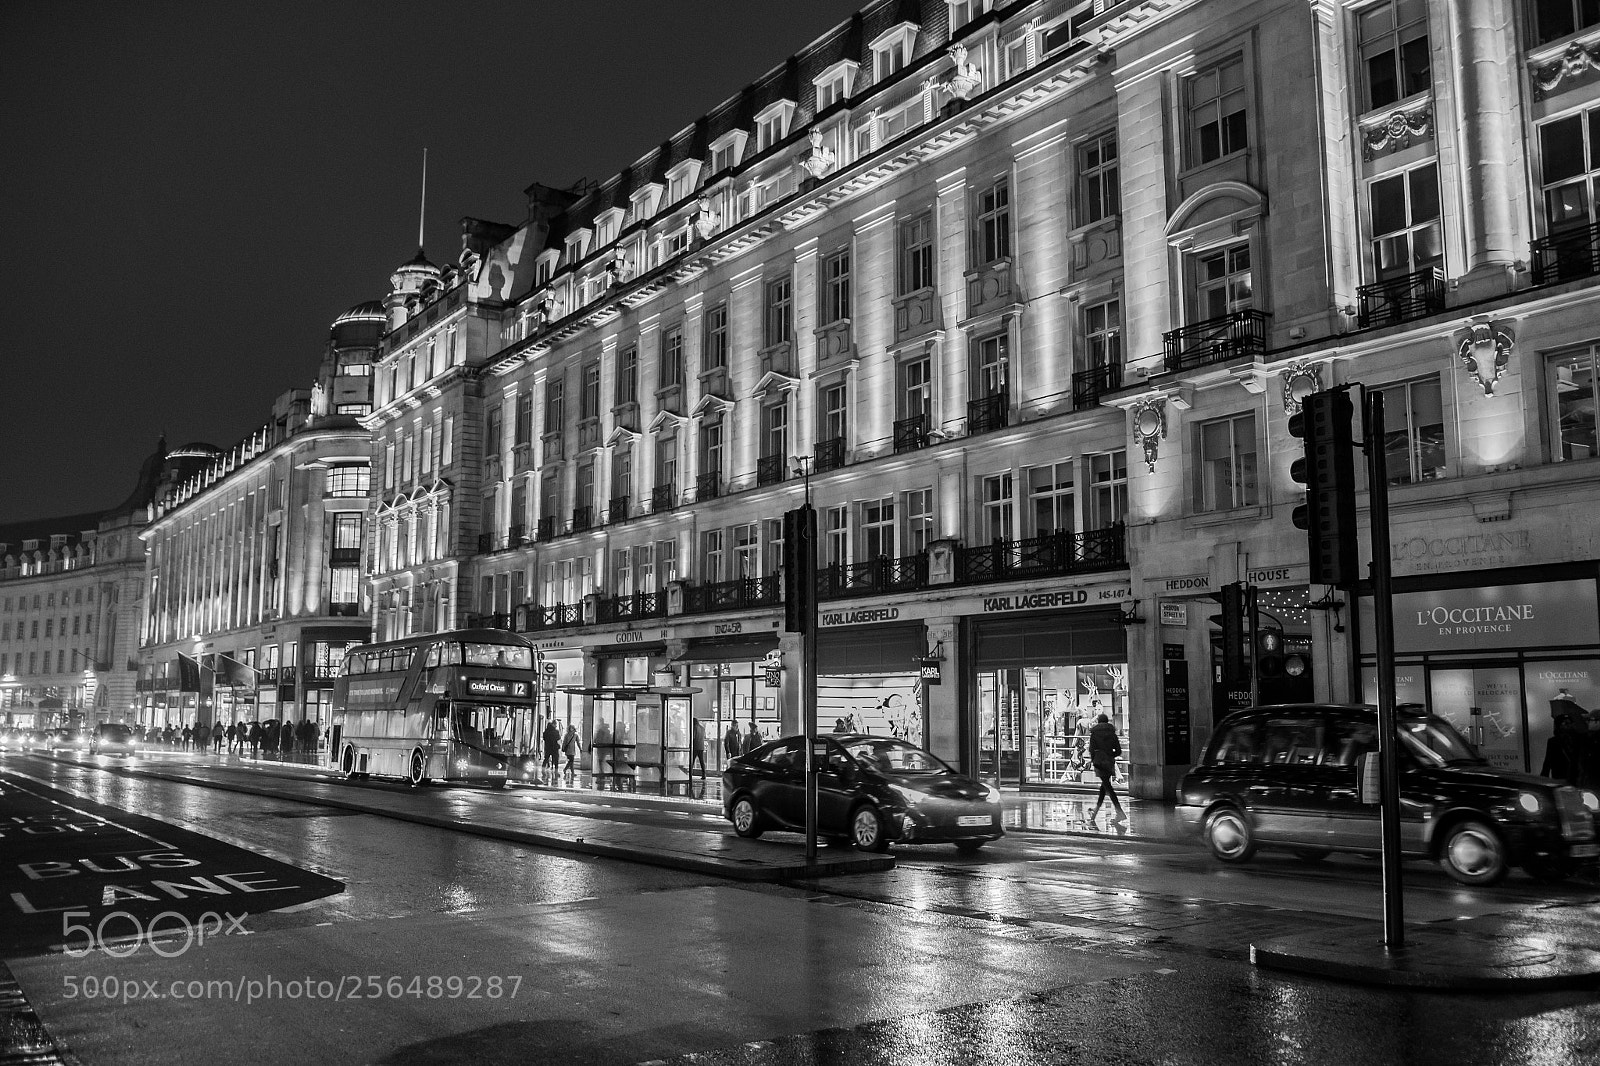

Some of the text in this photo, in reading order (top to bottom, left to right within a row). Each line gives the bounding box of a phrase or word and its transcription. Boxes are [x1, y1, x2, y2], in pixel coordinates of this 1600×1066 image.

[1166, 569, 1290, 590] HEDDON HOUSE
[984, 589, 1125, 611] KARL LAGERFELD 145-147
[822, 608, 899, 625] KARL LAGERFELD
[1417, 604, 1535, 626] L'OCCITANE
[616, 631, 643, 643] GODIVA
[1439, 624, 1512, 635] EN PROVENCE
[921, 666, 940, 675] KARL
[471, 683, 490, 692] Oxford
[514, 683, 525, 695] 12
[18, 853, 202, 880] BUS
[10, 871, 301, 914] LANE
